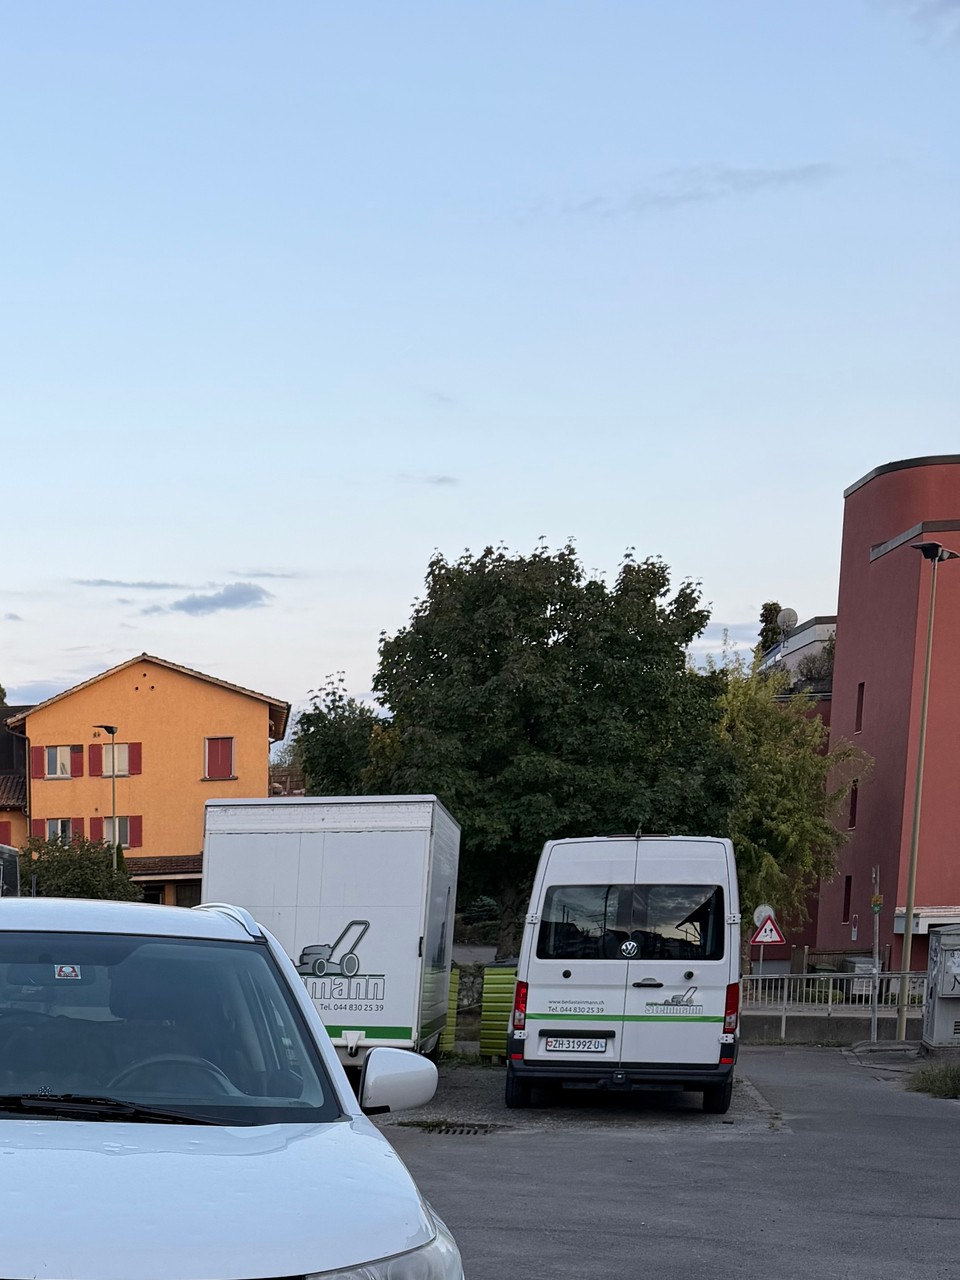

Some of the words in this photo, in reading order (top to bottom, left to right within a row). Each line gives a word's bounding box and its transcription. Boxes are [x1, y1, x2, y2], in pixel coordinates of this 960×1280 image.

[320, 1003, 332, 1011] Tel.
[333, 1003, 347, 1011] 044
[348, 1003, 362, 1011] 830
[374, 1004, 384, 1012] 39
